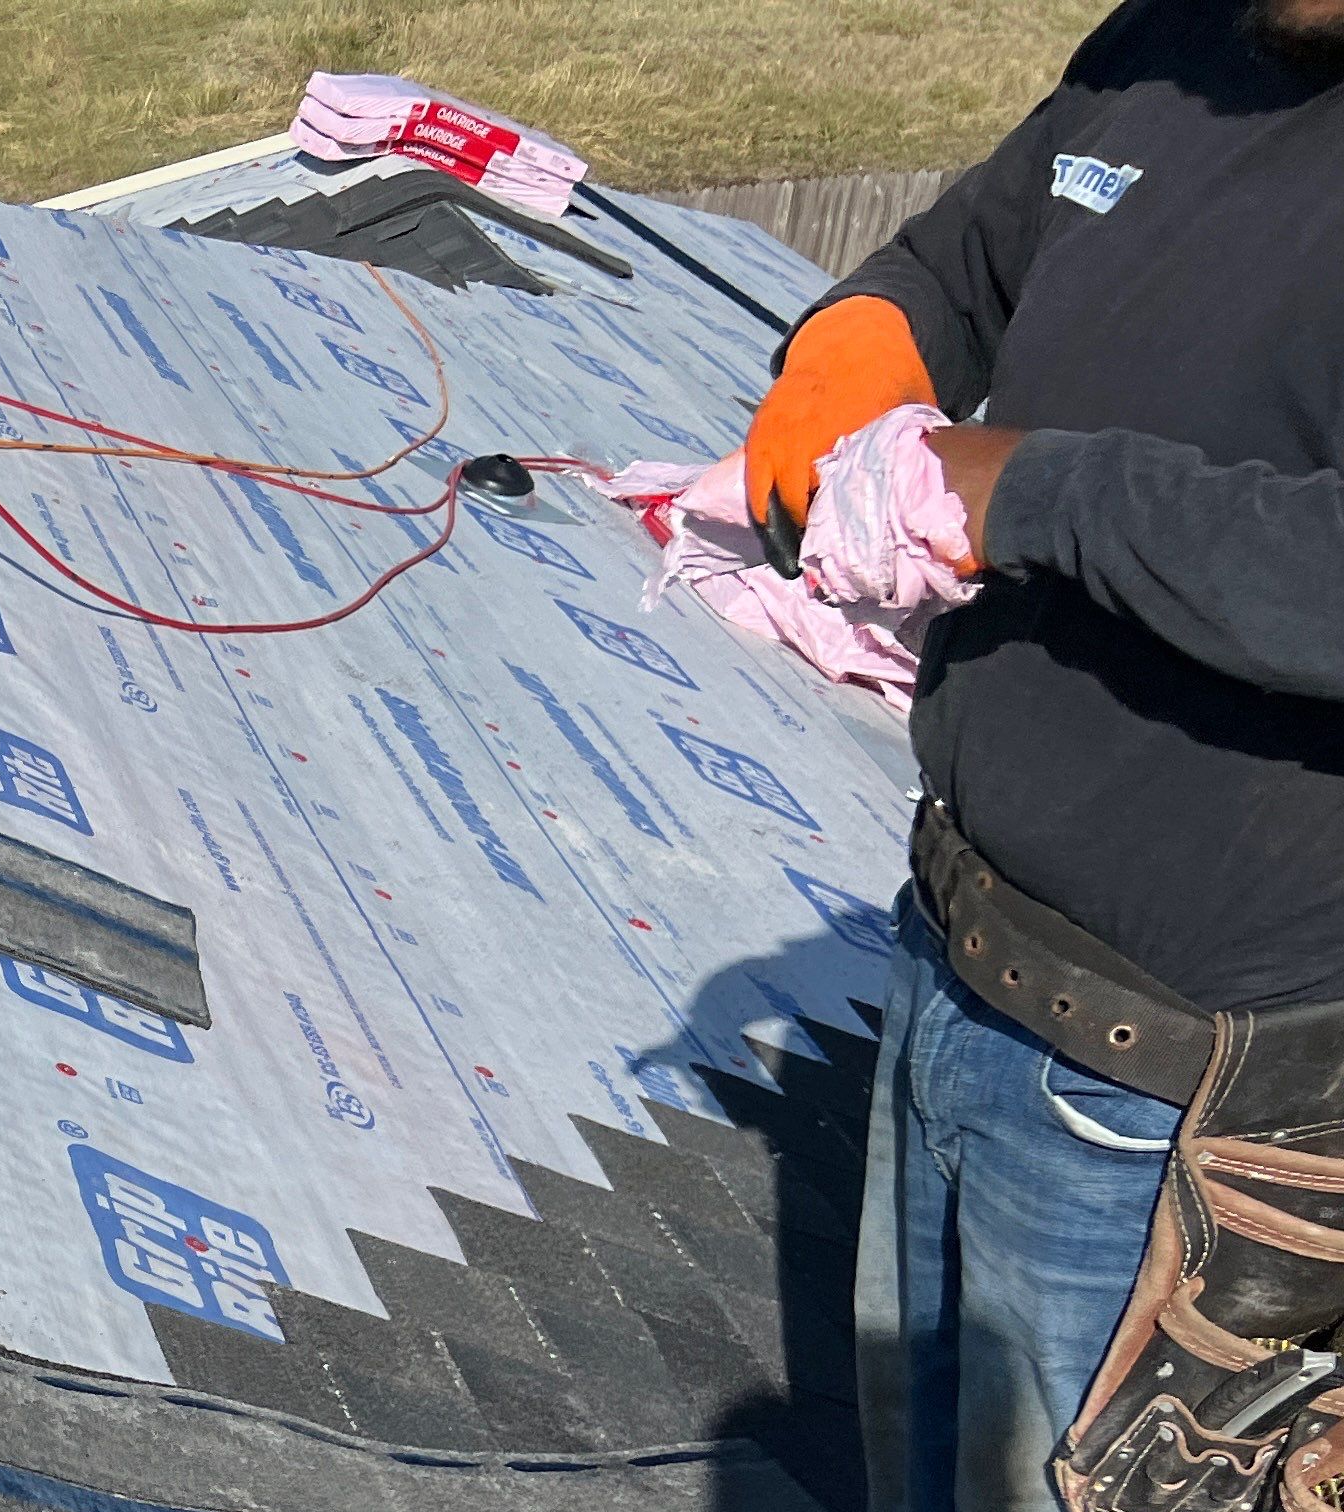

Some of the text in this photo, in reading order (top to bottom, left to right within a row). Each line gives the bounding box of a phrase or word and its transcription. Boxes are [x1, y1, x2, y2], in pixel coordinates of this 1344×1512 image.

[414, 124, 467, 151] OAKRIDGE
[436, 107, 492, 139] OAKRIDGE
[96, 1172, 206, 1310] Grip
[199, 1215, 286, 1344] Rite
